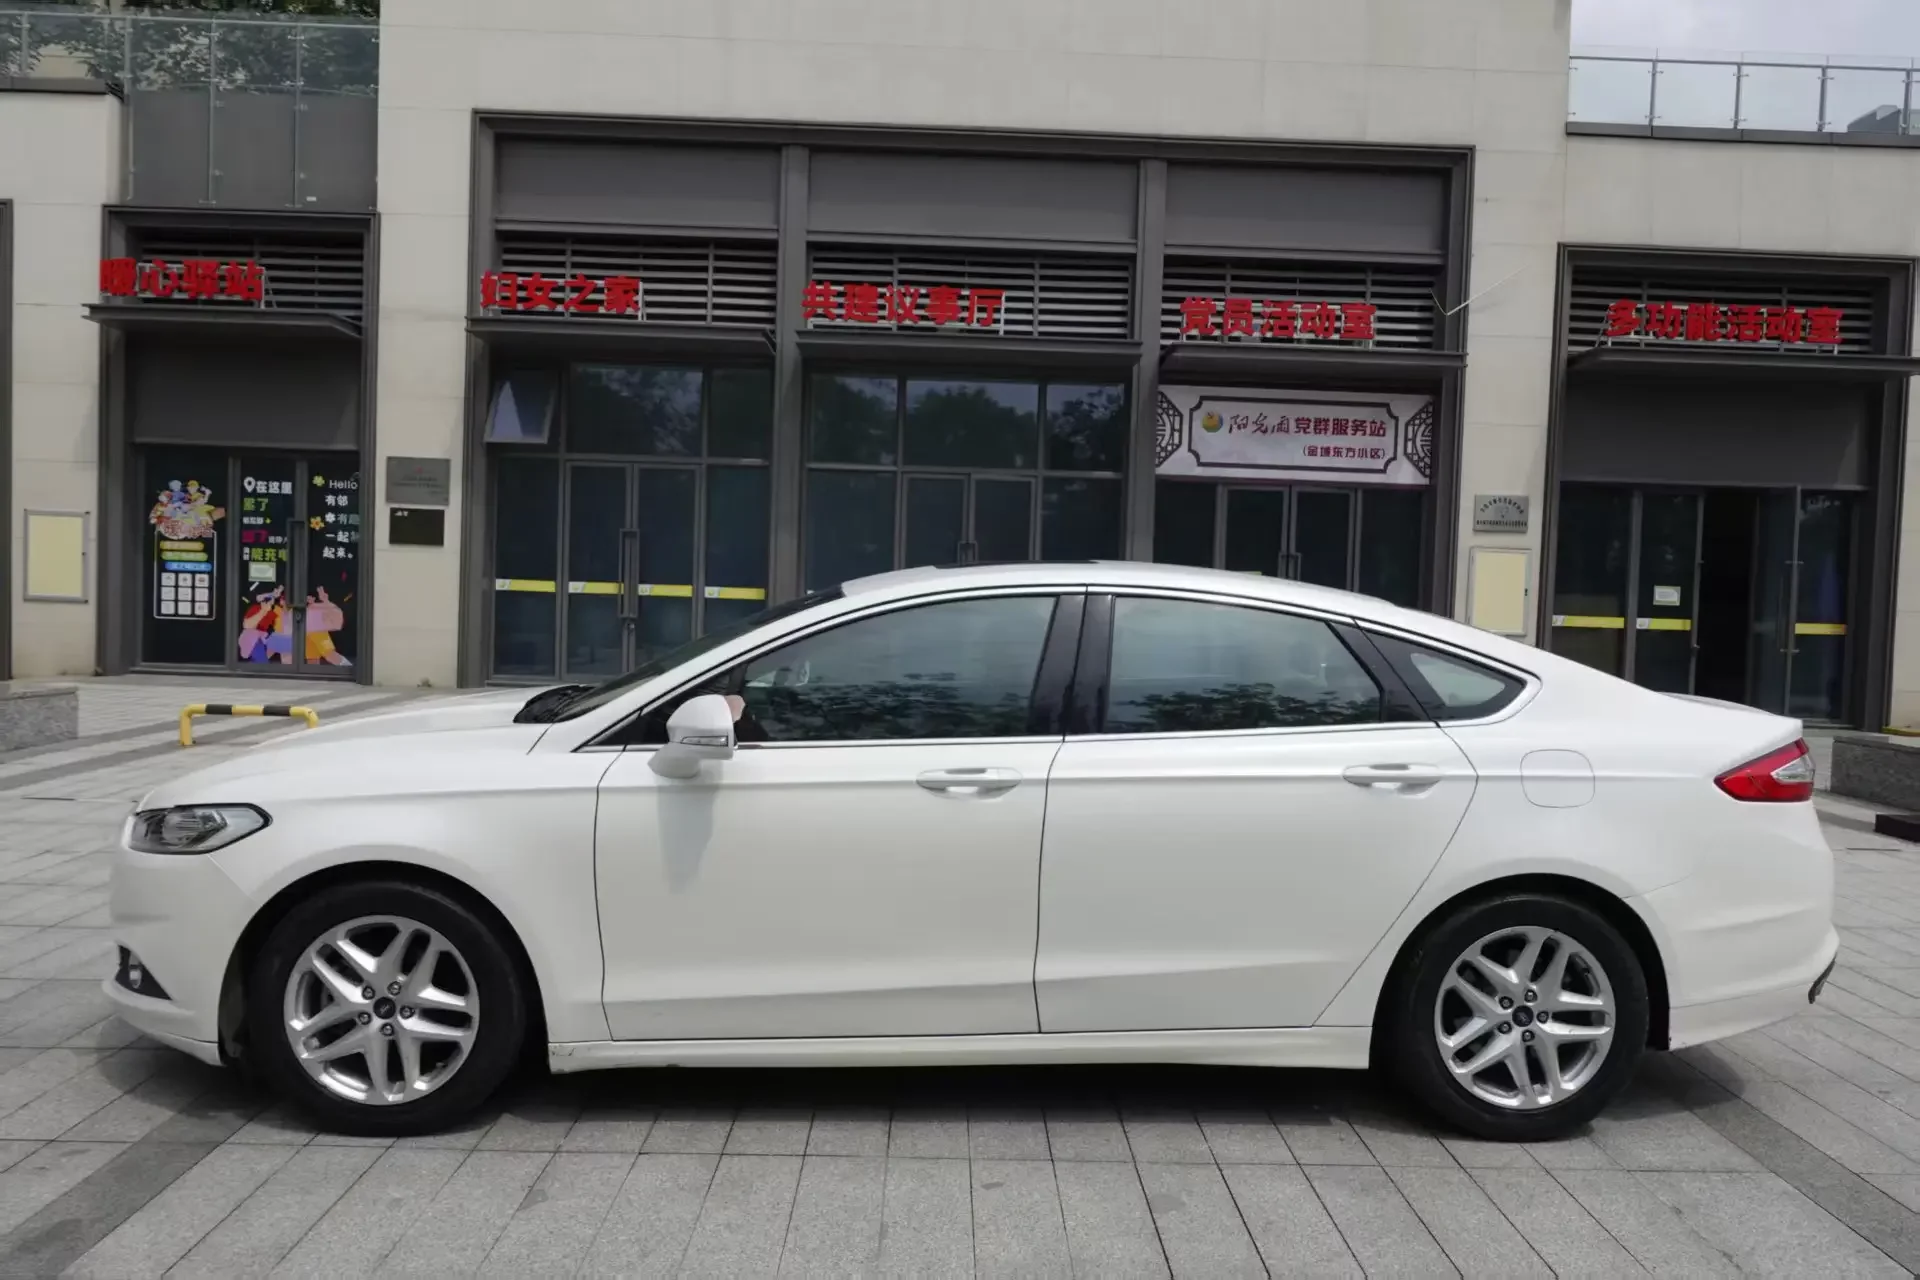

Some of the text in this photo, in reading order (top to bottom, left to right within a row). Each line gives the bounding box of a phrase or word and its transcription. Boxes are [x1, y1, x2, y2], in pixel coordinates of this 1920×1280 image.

[99, 257, 264, 301] 暖心驿站
[480, 269, 640, 314] 妇女之家
[802, 280, 1005, 327] 共建议事厅
[1179, 296, 1376, 340] 党员活动室
[1606, 297, 1844, 345] 多功能活动室
[256, 480, 293, 495] 在这里
[329, 480, 358, 490] Hello
